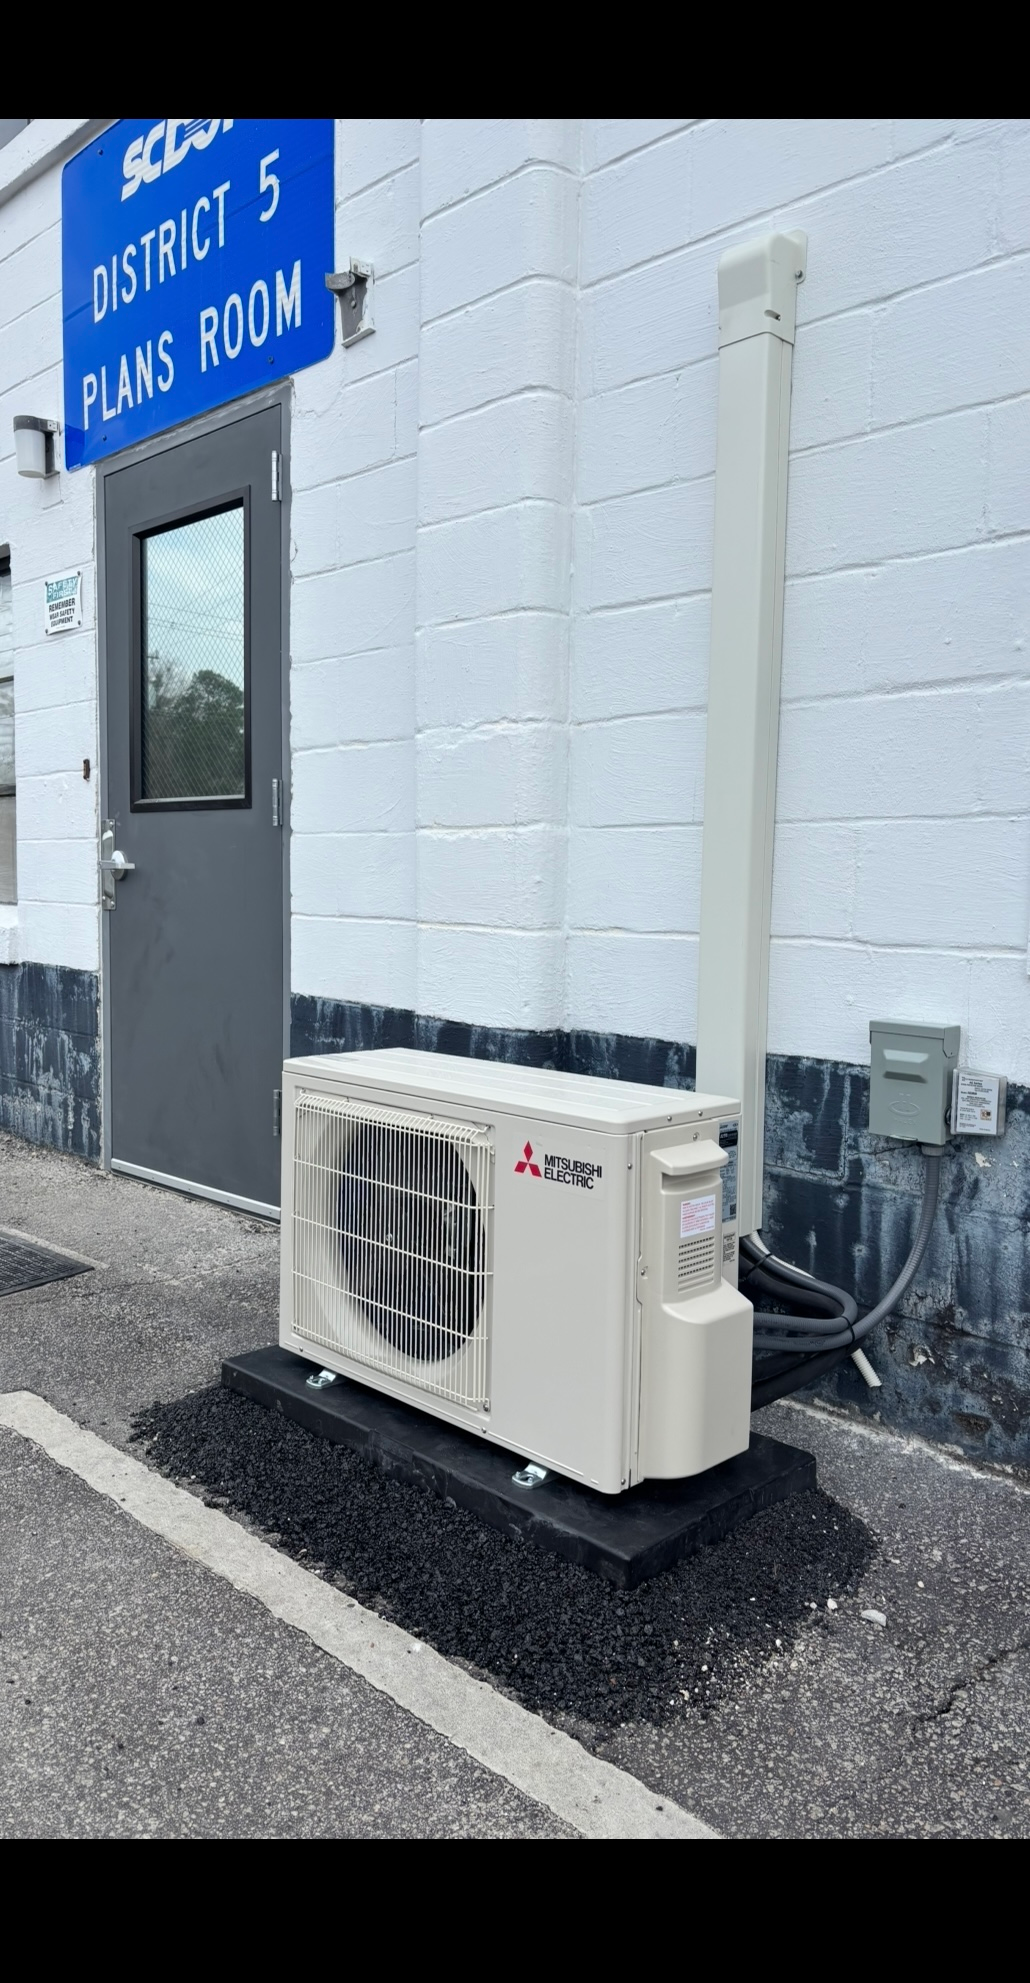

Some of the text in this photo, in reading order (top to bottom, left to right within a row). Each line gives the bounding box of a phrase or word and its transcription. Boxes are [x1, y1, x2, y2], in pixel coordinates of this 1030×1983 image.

[93, 148, 280, 324] DISTRICT 5
[83, 259, 302, 431] PLANS ROOM
[48, 578, 76, 596] SAFETY
[49, 598, 75, 612] REMEMBER
[50, 608, 75, 620] WEAR SAFETY
[51, 616, 73, 627] EQUIPMENT
[544, 1154, 602, 1178] MITSUBISHI
[544, 1167, 594, 1190] ELECTRIC
